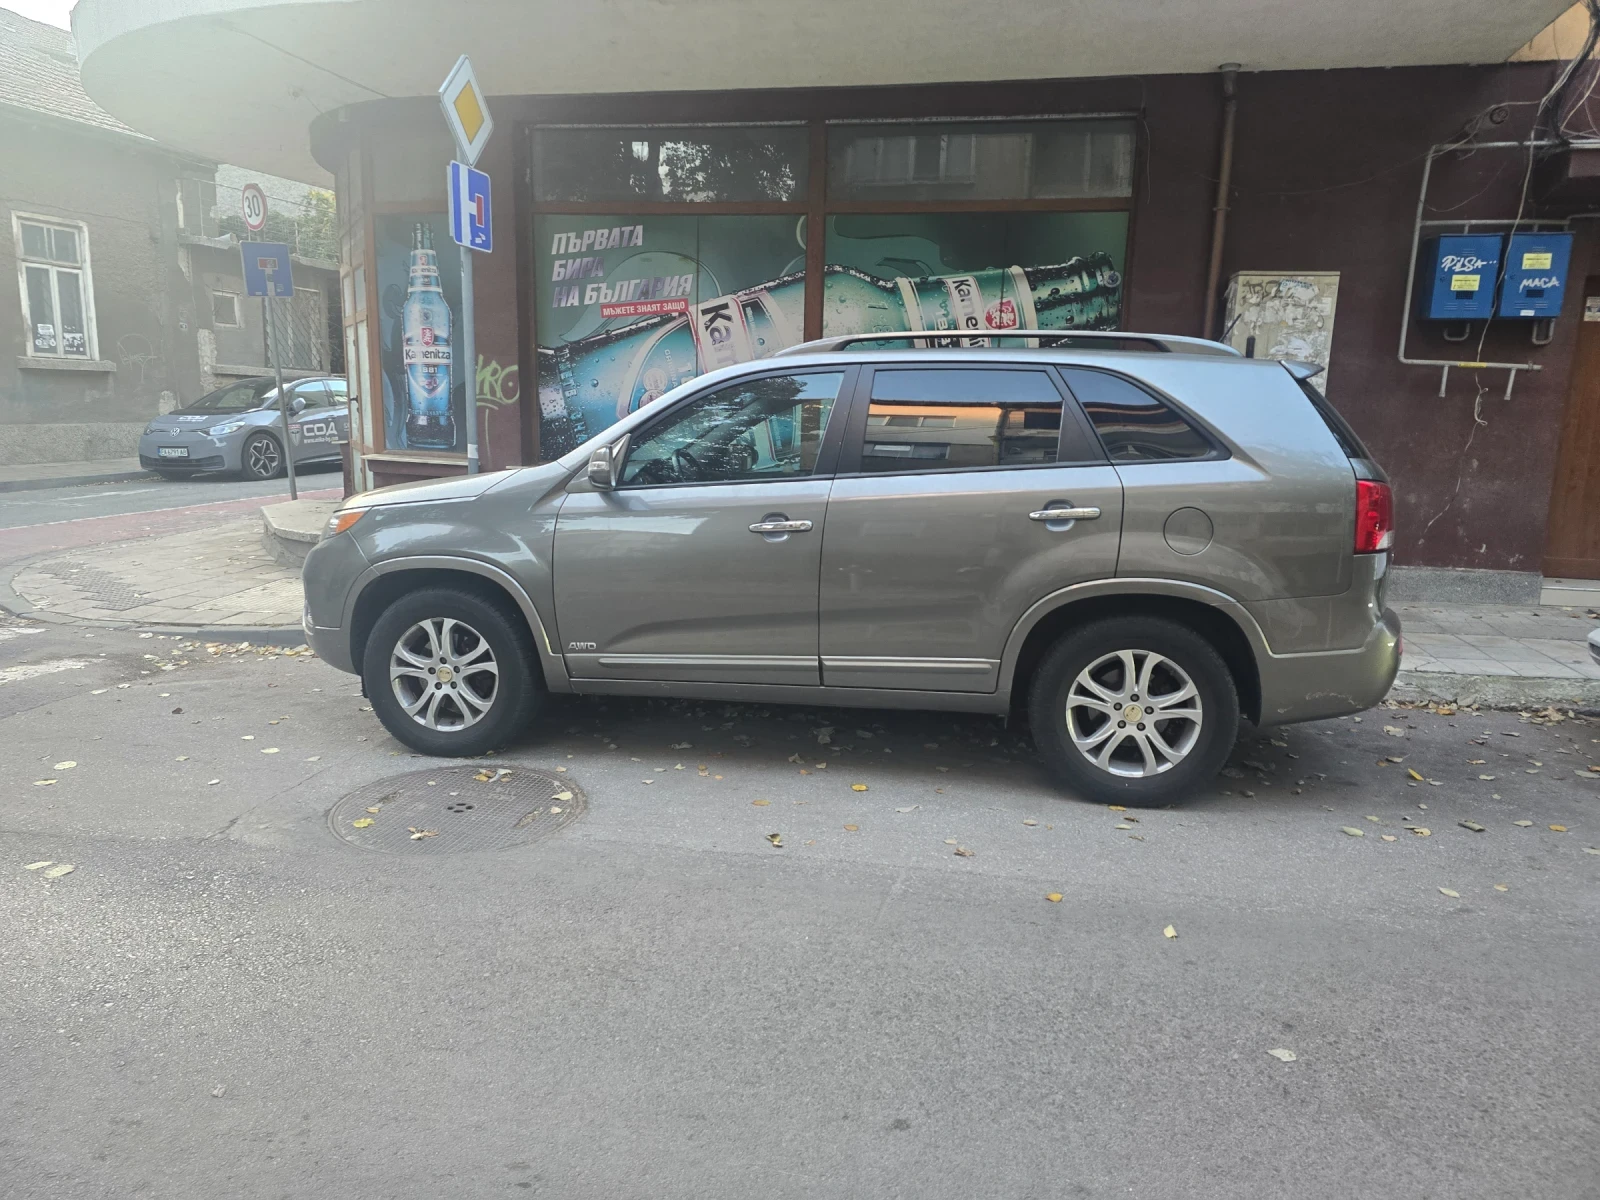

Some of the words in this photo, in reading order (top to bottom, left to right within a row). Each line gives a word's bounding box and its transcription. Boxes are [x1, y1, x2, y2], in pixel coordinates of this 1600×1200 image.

[244, 194, 261, 218] 30
[551, 225, 643, 254] ПЪРВАТА
[552, 256, 605, 282] БИРА
[552, 285, 580, 308] НА
[584, 274, 694, 306] БЪЛГАРИЯ
[602, 304, 635, 316] МЪЖЕТЕ
[636, 303, 661, 313] ЗНАЯТ
[662, 301, 686, 312] ЗАЩО
[568, 641, 597, 650] AWD
